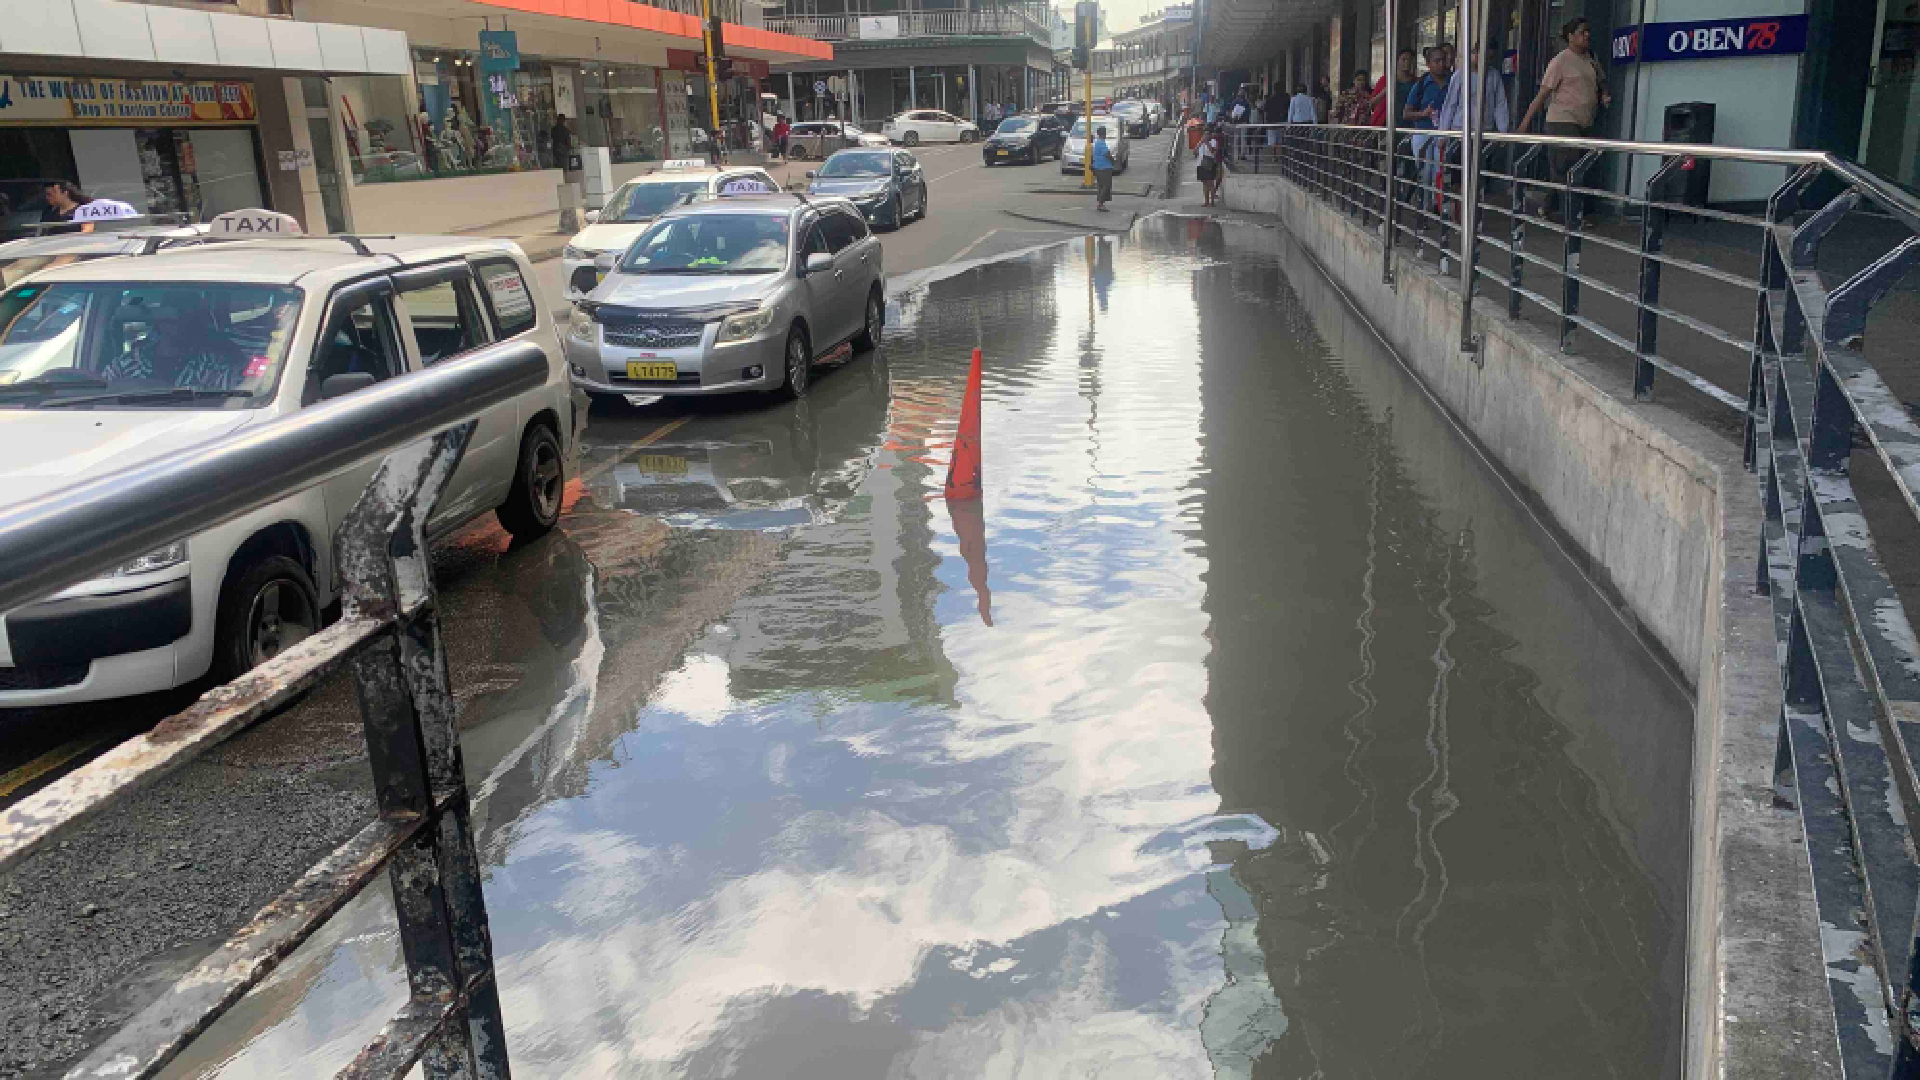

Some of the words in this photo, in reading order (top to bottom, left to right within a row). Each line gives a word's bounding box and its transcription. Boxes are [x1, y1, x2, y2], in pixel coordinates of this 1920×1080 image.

[19, 80, 46, 98] THE
[48, 81, 96, 99] WORLD
[99, 82, 115, 100] OF
[171, 84, 184, 101] AT
[74, 103, 101, 117] Shop
[730, 182, 760, 191] TAXI
[80, 205, 118, 217] TAXI
[218, 216, 281, 233] TAXI
